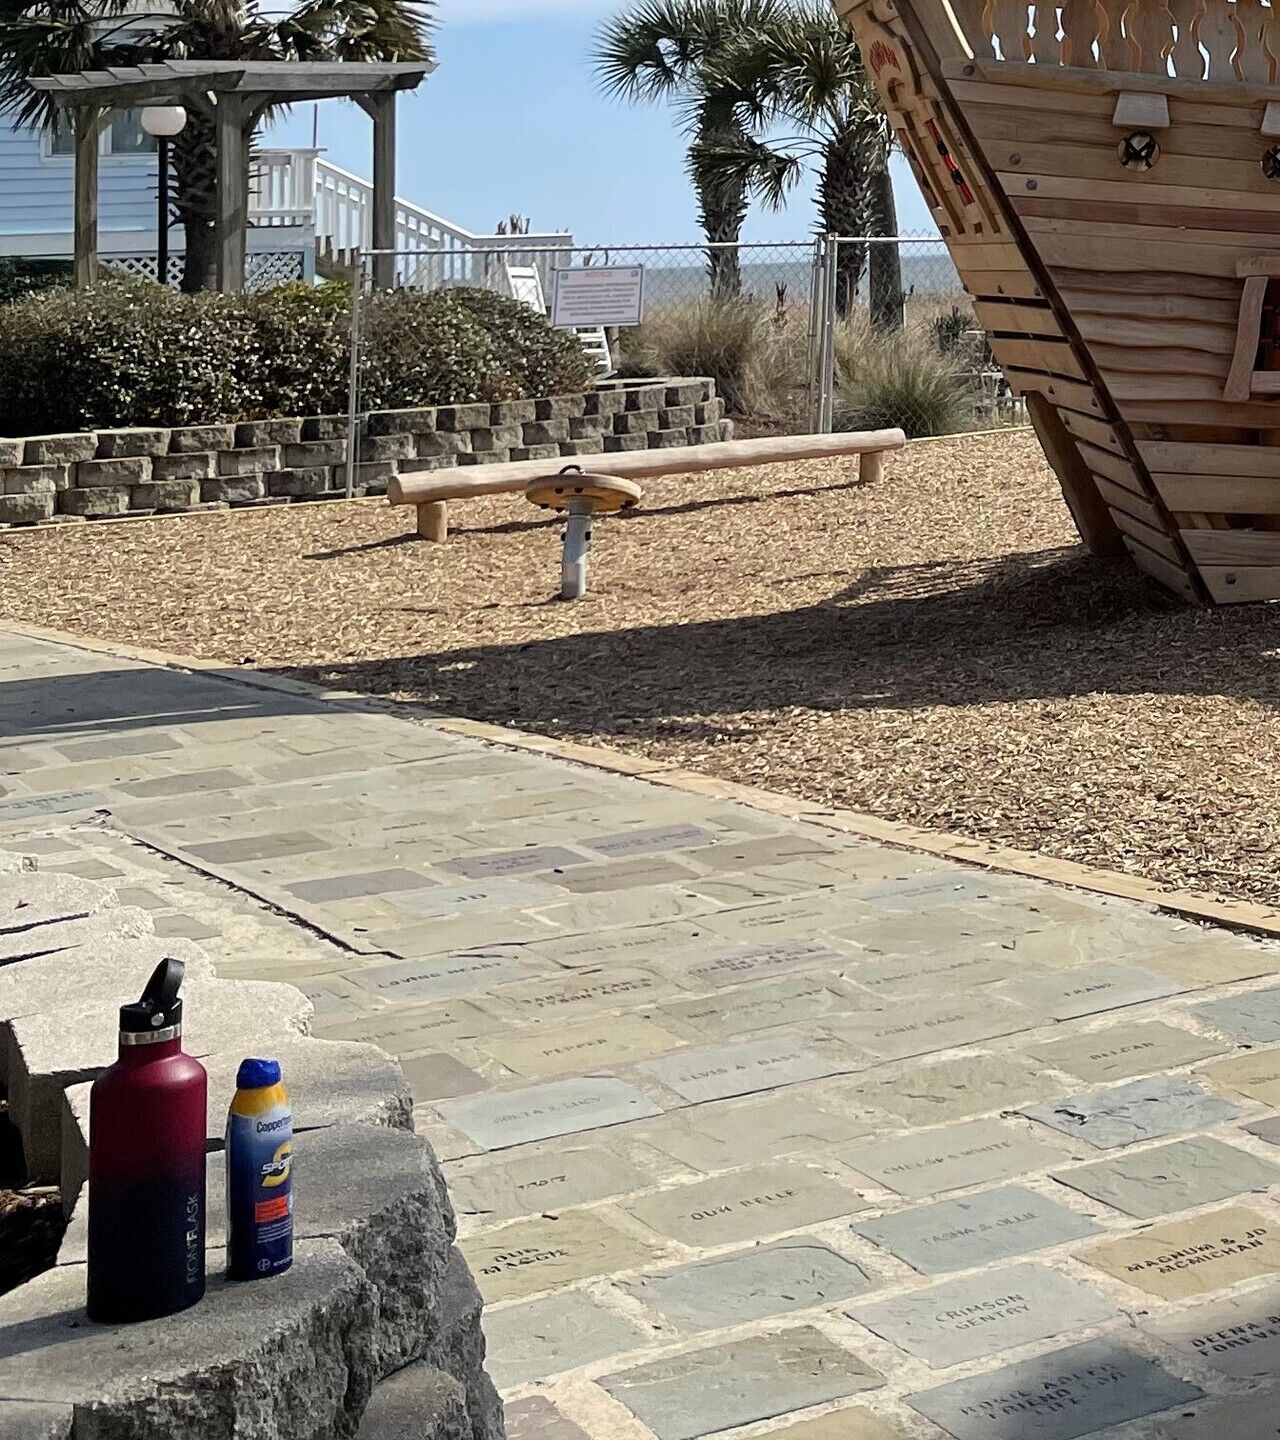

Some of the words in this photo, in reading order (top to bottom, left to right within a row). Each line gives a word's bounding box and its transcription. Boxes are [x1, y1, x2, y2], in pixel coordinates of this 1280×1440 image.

[1126, 1242, 1216, 1273] MAGNUM
[1245, 1227, 1268, 1240] JD
[1157, 1238, 1265, 1275] MCMICHAN
[934, 1293, 1025, 1323] CRIMSON
[954, 1303, 1031, 1330] GENTRY
[1191, 1321, 1262, 1350] DEENA
